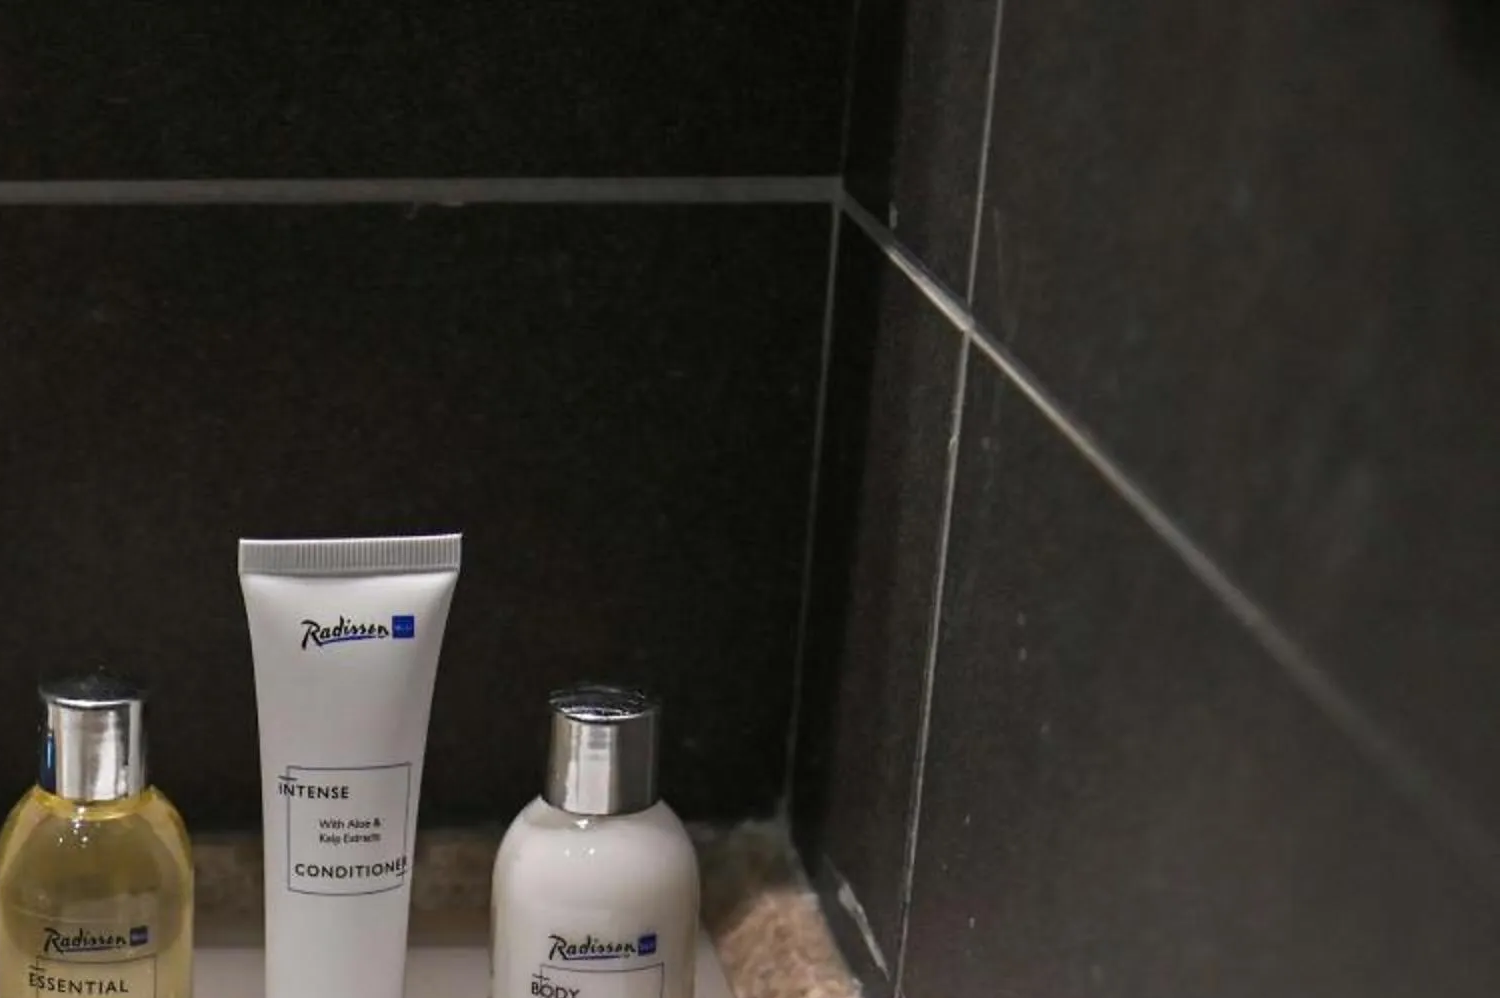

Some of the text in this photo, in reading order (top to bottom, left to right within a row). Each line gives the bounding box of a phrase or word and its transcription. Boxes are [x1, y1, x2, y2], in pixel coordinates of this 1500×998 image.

[301, 615, 389, 650] Radisson
[278, 784, 350, 800] INTENSE
[318, 819, 345, 829] With
[347, 819, 371, 829] Aloe
[319, 833, 381, 846] Kelp Extracts
[43, 927, 128, 953] Radisson
[548, 933, 637, 960] Radisson
[28, 972, 129, 994] ESSENTIAL
